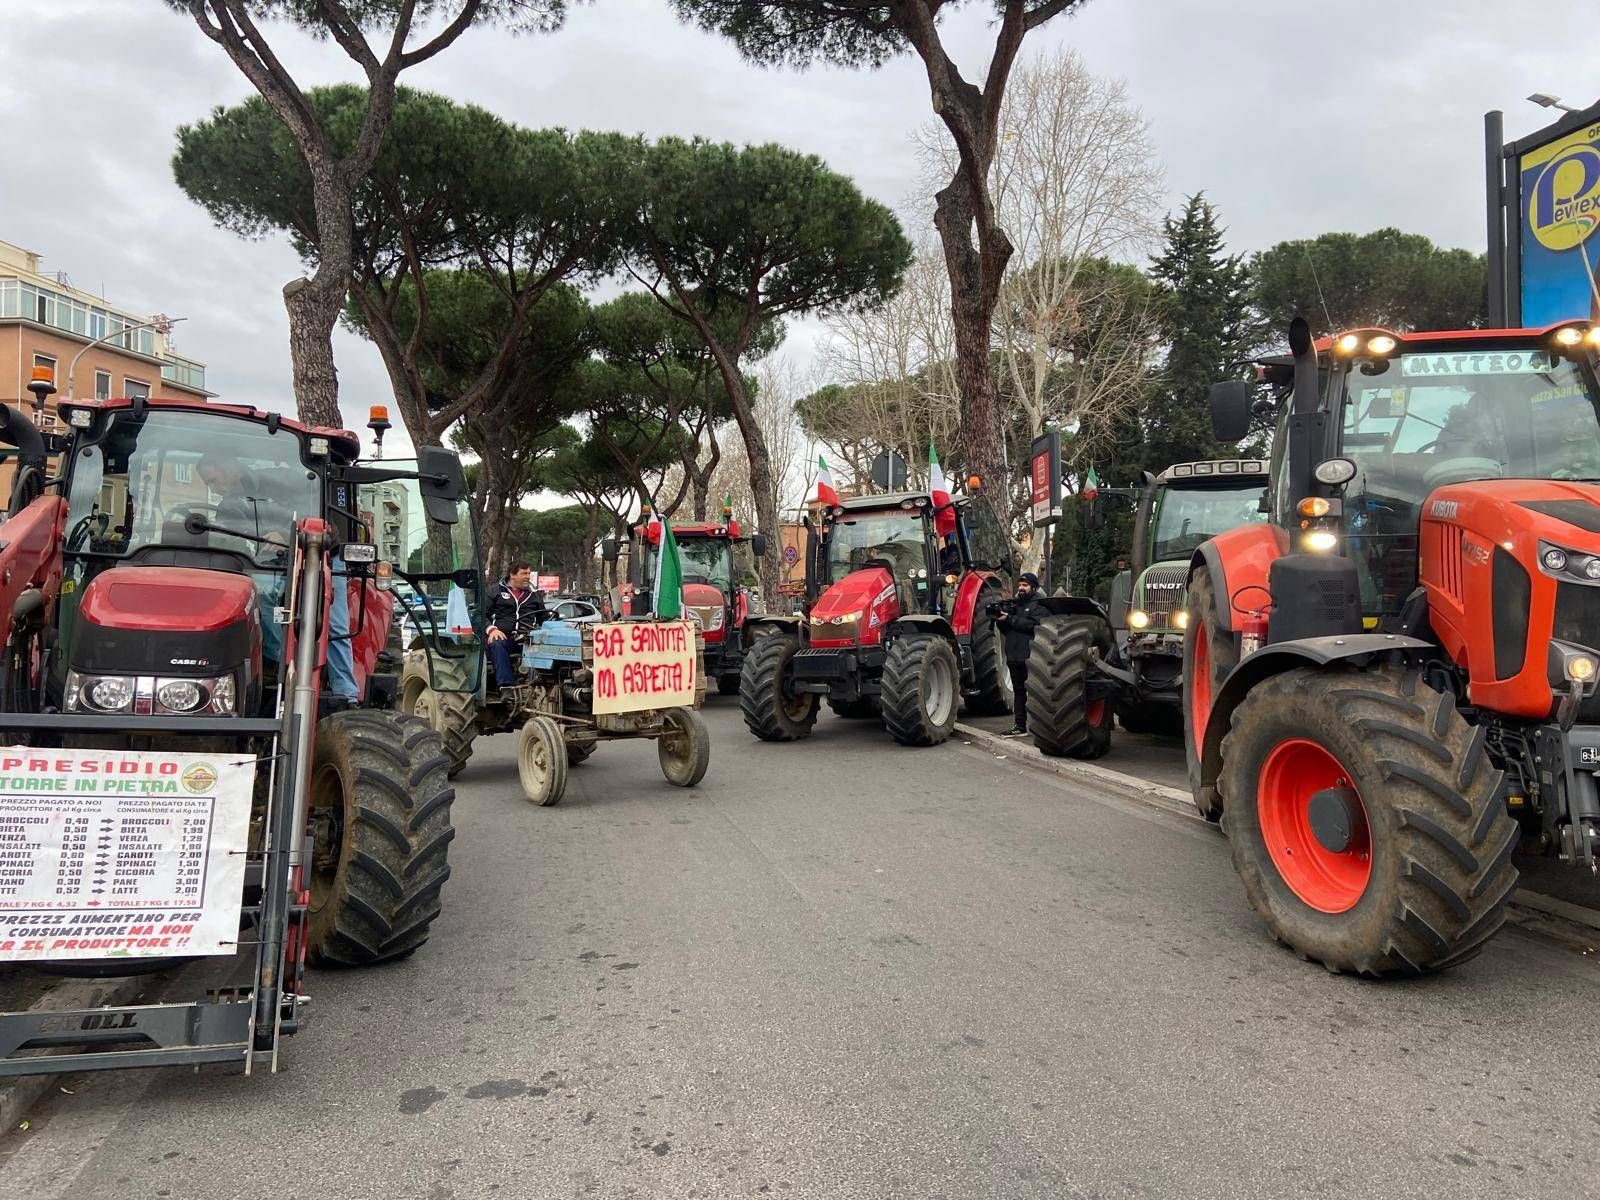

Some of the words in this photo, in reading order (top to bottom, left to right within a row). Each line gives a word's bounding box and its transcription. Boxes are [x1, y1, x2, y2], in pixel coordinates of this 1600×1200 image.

[1410, 354, 1523, 374] MATTEO
[1431, 500, 1458, 519] KUBOTA
[595, 627, 624, 658] SUA
[598, 668, 617, 698] MI
[3, 758, 178, 775] PRESIDIO
[0, 777, 67, 790] TORRE
[75, 779, 97, 791] IN
[104, 779, 178, 793] PIETRA
[1, 851, 32, 859] AROTE
[69, 914, 164, 924] AUMENTANO
[169, 912, 202, 921] PER
[9, 926, 127, 937] CONSUMATORE
[128, 925, 154, 935] MA
[160, 924, 194, 935] NON
[51, 938, 172, 949] PRODUTTORE
